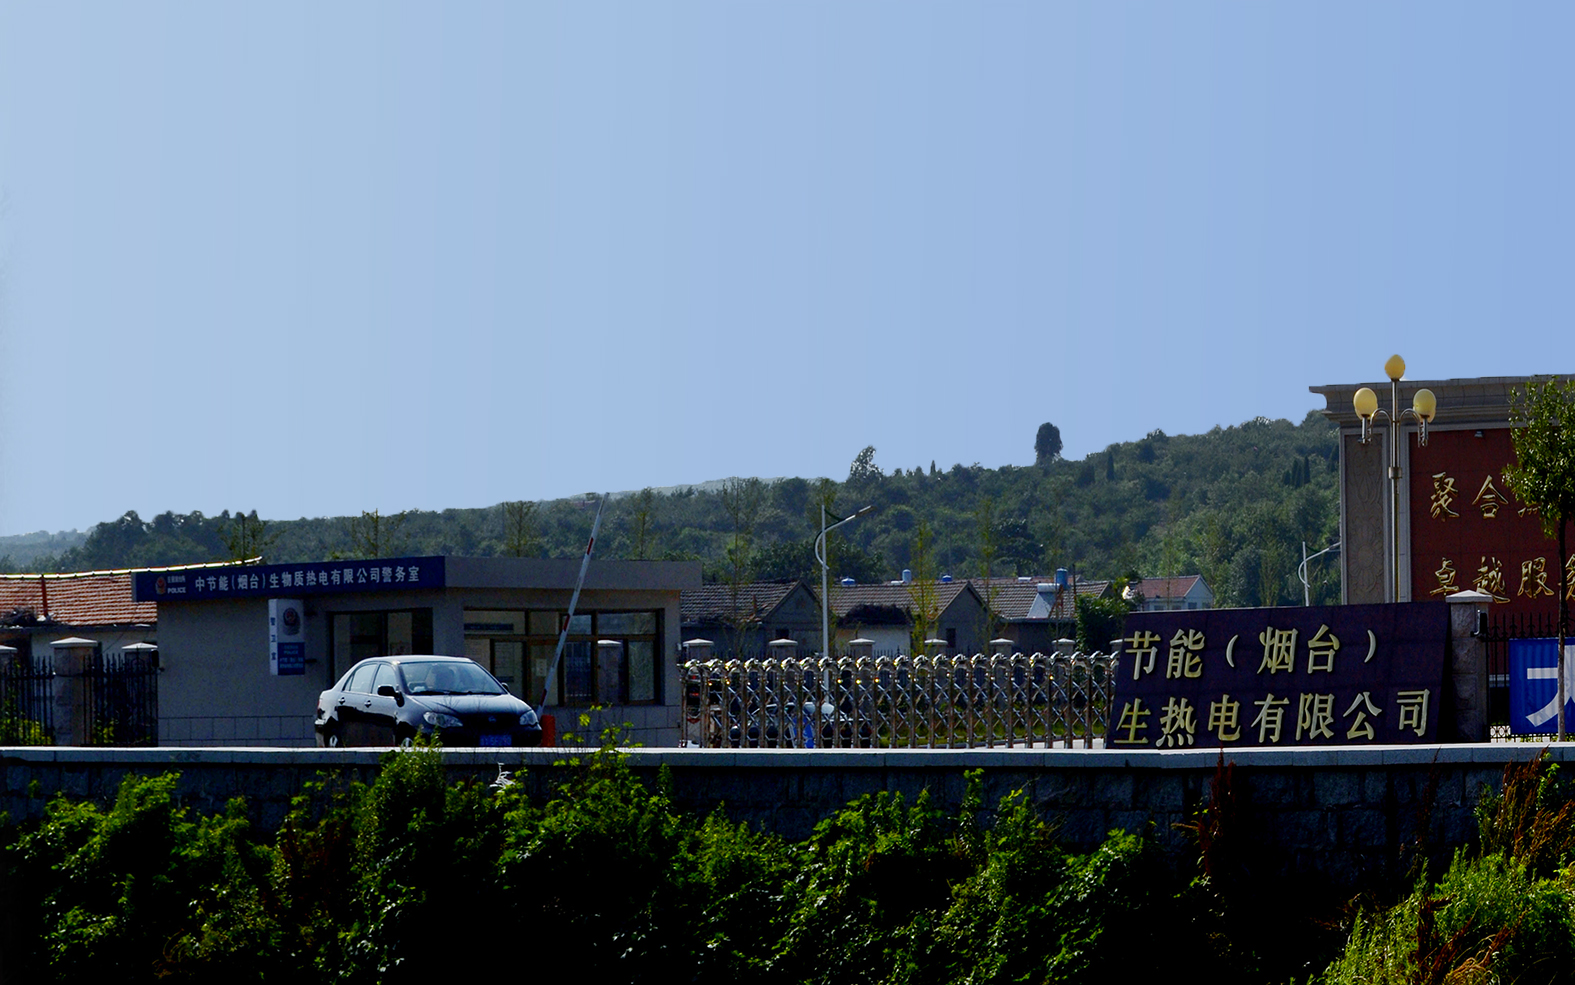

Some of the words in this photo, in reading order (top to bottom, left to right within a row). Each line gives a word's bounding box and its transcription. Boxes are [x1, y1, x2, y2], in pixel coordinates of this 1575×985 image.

[167, 586, 187, 594] POLICE
[1113, 688, 1431, 748] 生热电有限公司
